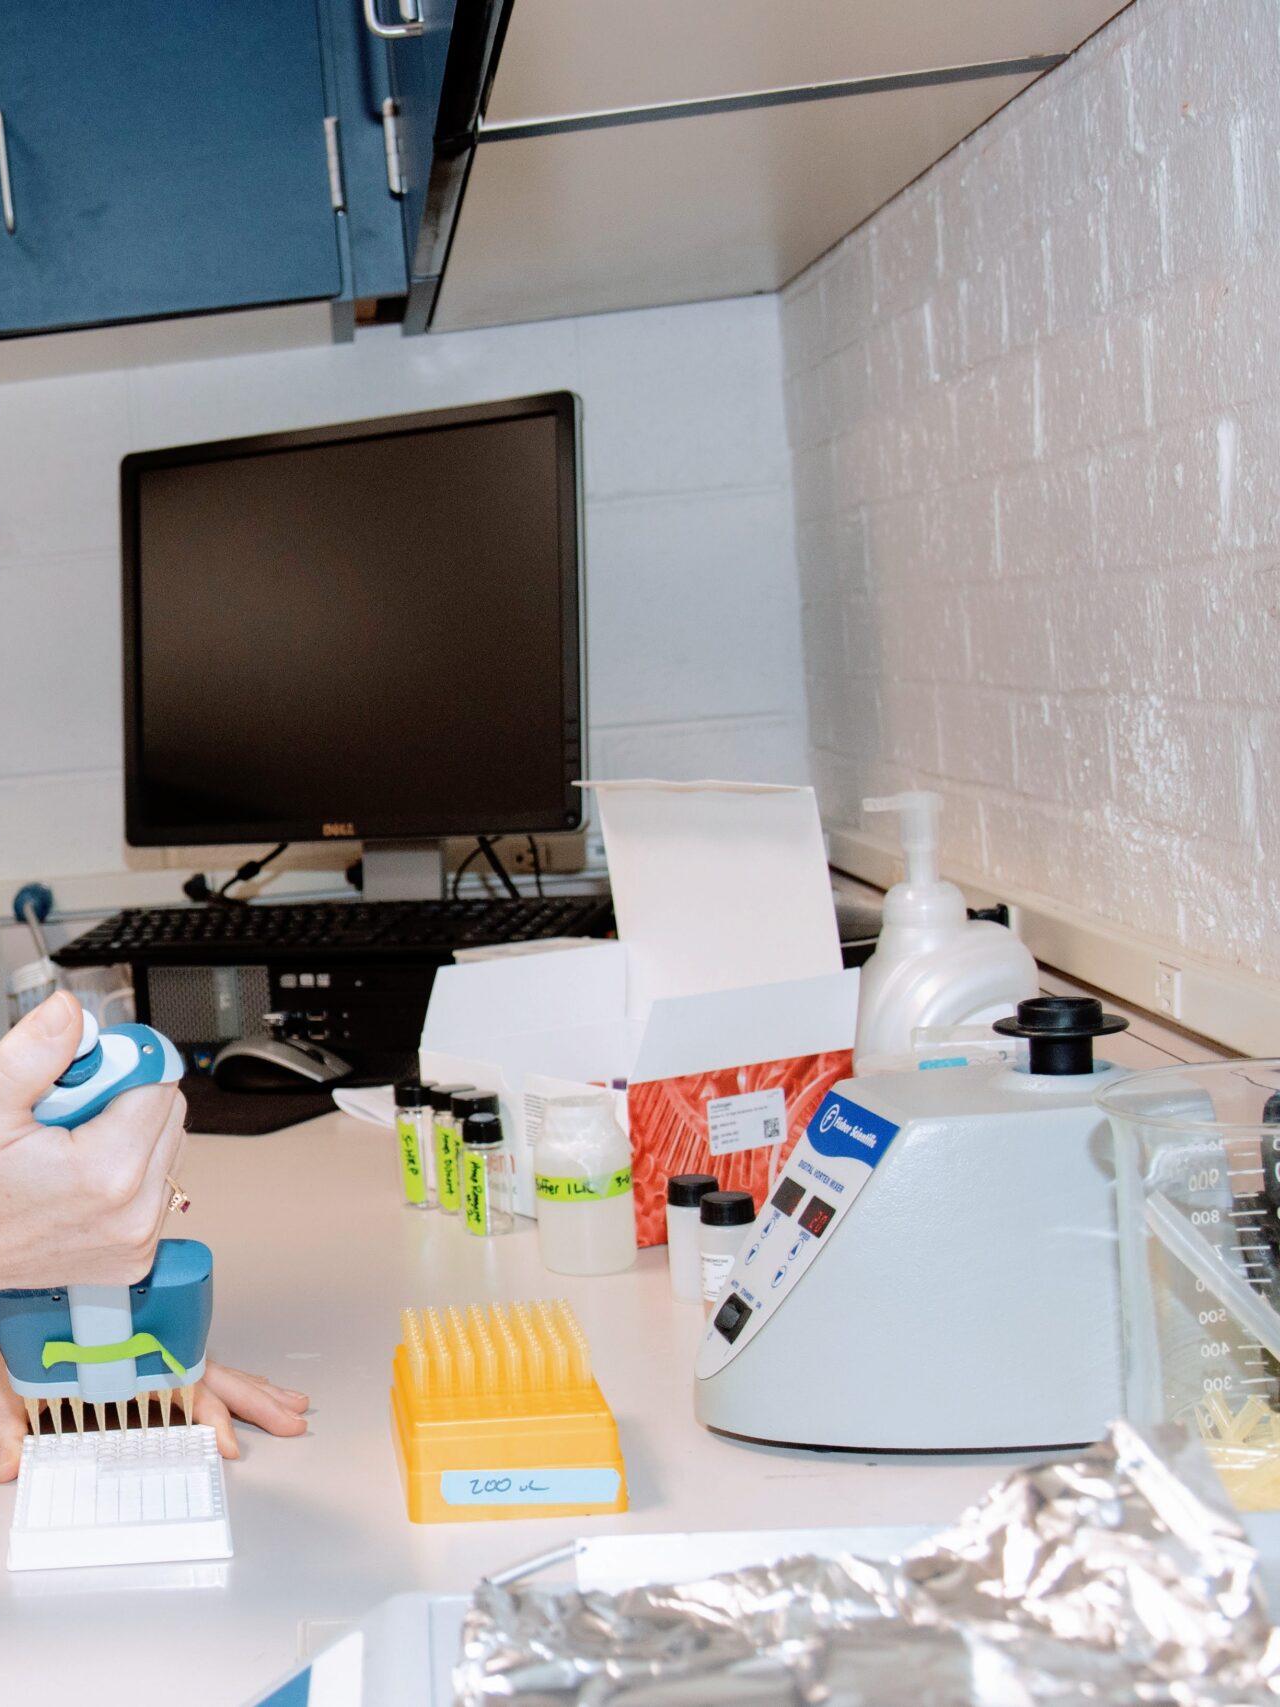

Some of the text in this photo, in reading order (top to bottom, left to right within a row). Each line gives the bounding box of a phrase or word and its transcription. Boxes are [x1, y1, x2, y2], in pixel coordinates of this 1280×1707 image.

[833, 1116, 851, 1136] Fisher
[849, 1125, 877, 1149] Scientific
[535, 1177, 559, 1196] uffer
[813, 1167, 831, 1186] VORTEX
[830, 1178, 845, 1194] MIXER
[469, 1477, 512, 1495] 200
